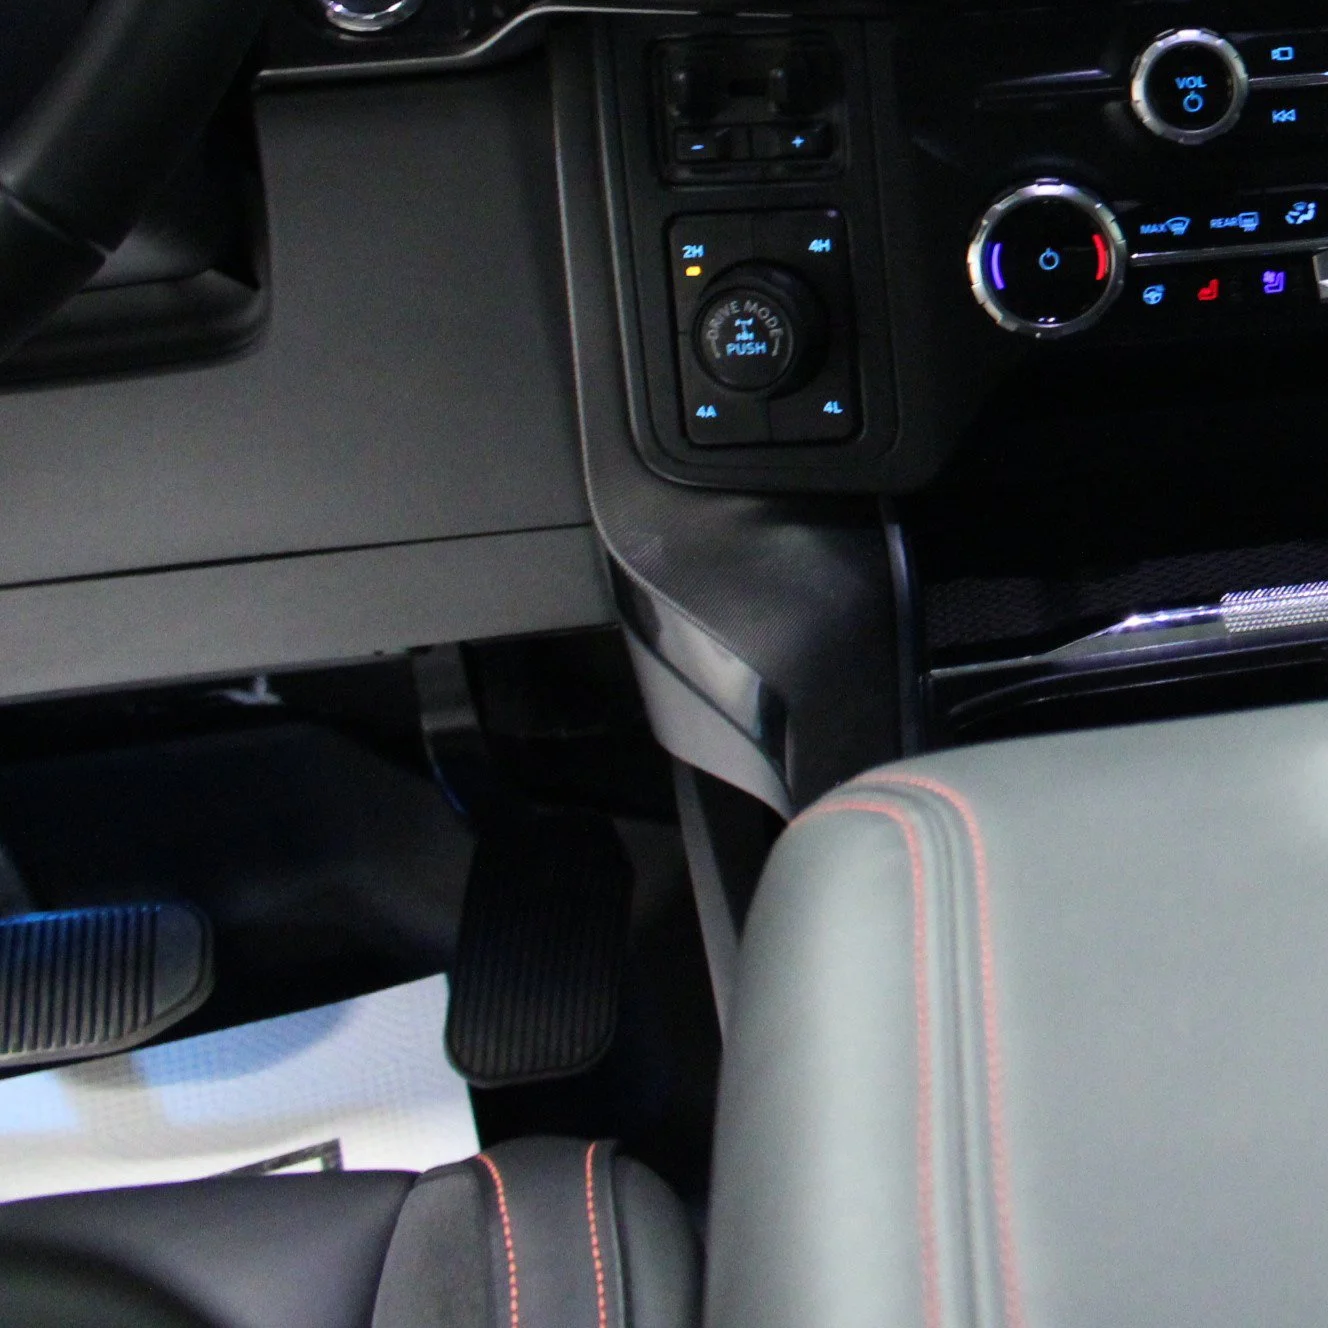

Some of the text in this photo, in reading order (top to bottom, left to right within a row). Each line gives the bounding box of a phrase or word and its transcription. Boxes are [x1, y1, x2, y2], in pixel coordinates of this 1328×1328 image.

[1175, 75, 1208, 90] VOL
[1139, 224, 1167, 234] MAX
[1210, 217, 1240, 229] REAR
[682, 244, 705, 259] 2H
[808, 238, 831, 253] 4H
[743, 300, 784, 339] MODE
[726, 341, 768, 356] PUSH
[695, 405, 717, 418] 4A
[823, 400, 844, 414] 4L
